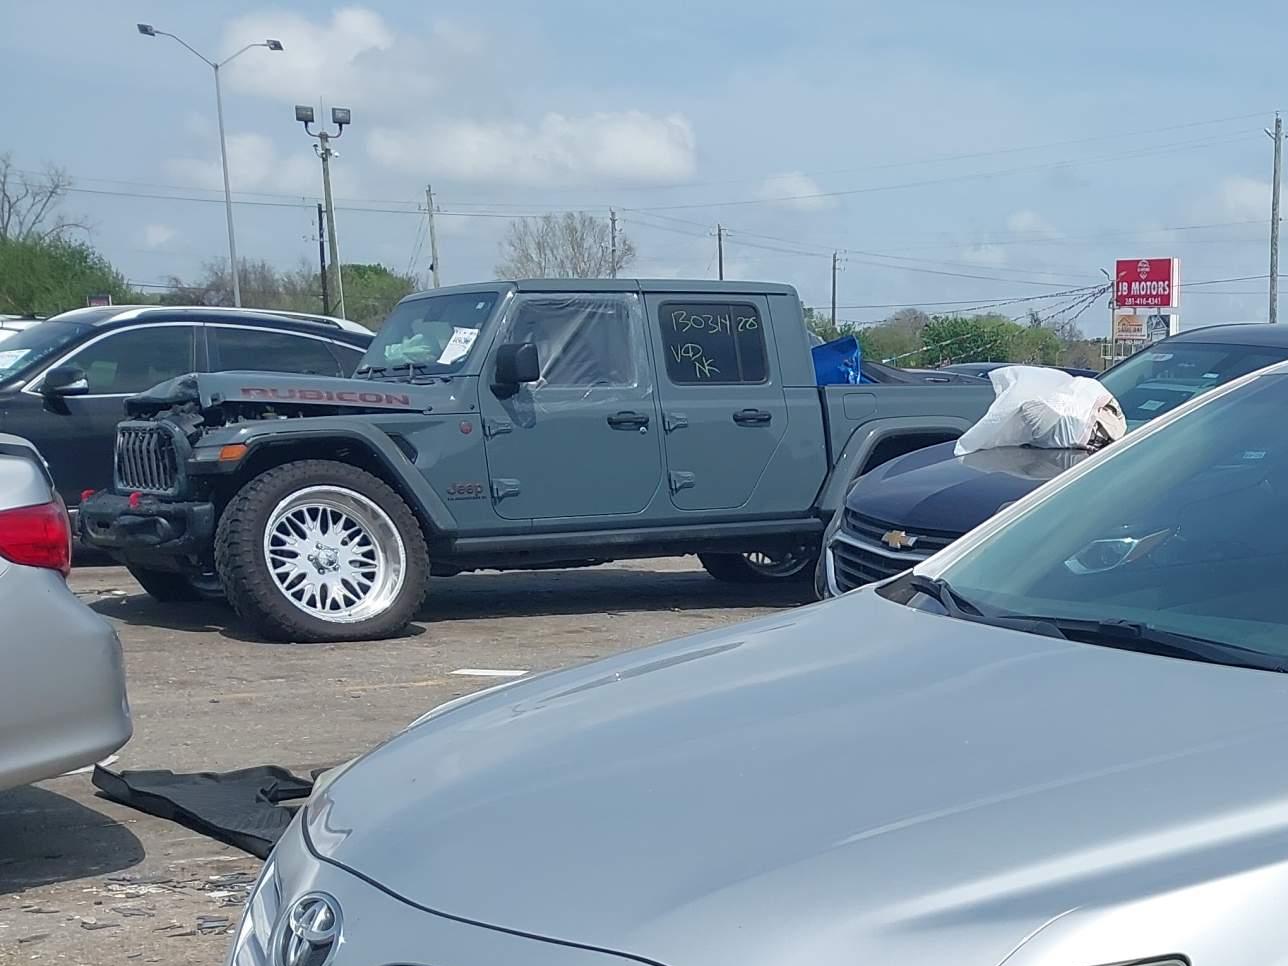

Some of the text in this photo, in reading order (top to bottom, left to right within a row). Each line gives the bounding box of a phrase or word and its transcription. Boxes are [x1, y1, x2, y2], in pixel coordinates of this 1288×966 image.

[1117, 281, 1169, 295] JB MOTORS
[240, 387, 410, 406] RUBICON
